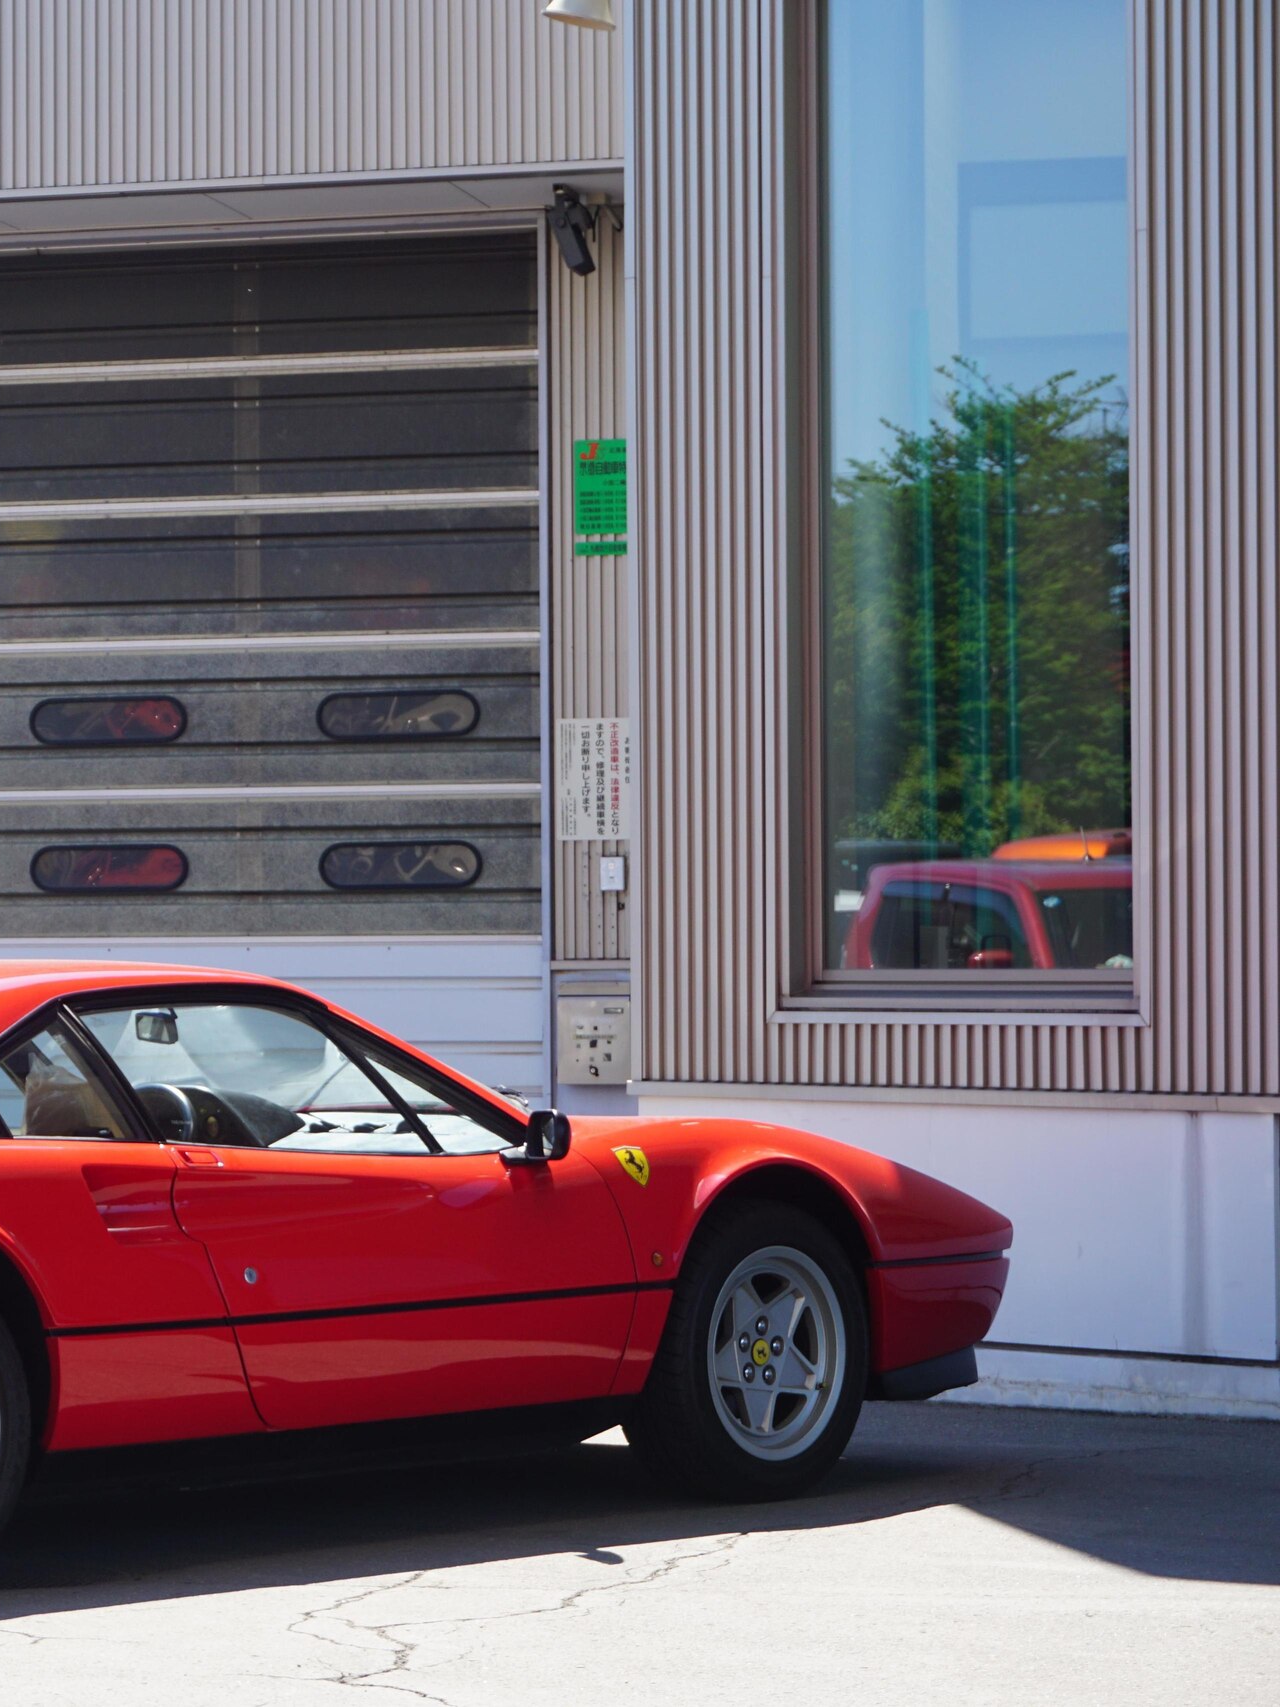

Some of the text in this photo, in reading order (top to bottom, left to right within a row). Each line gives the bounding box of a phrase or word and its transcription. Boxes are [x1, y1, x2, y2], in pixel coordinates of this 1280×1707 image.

[581, 725, 591, 818] 一切お断り申し上げます。
[610, 722, 620, 835] 不正改造車は、法律違反となり
